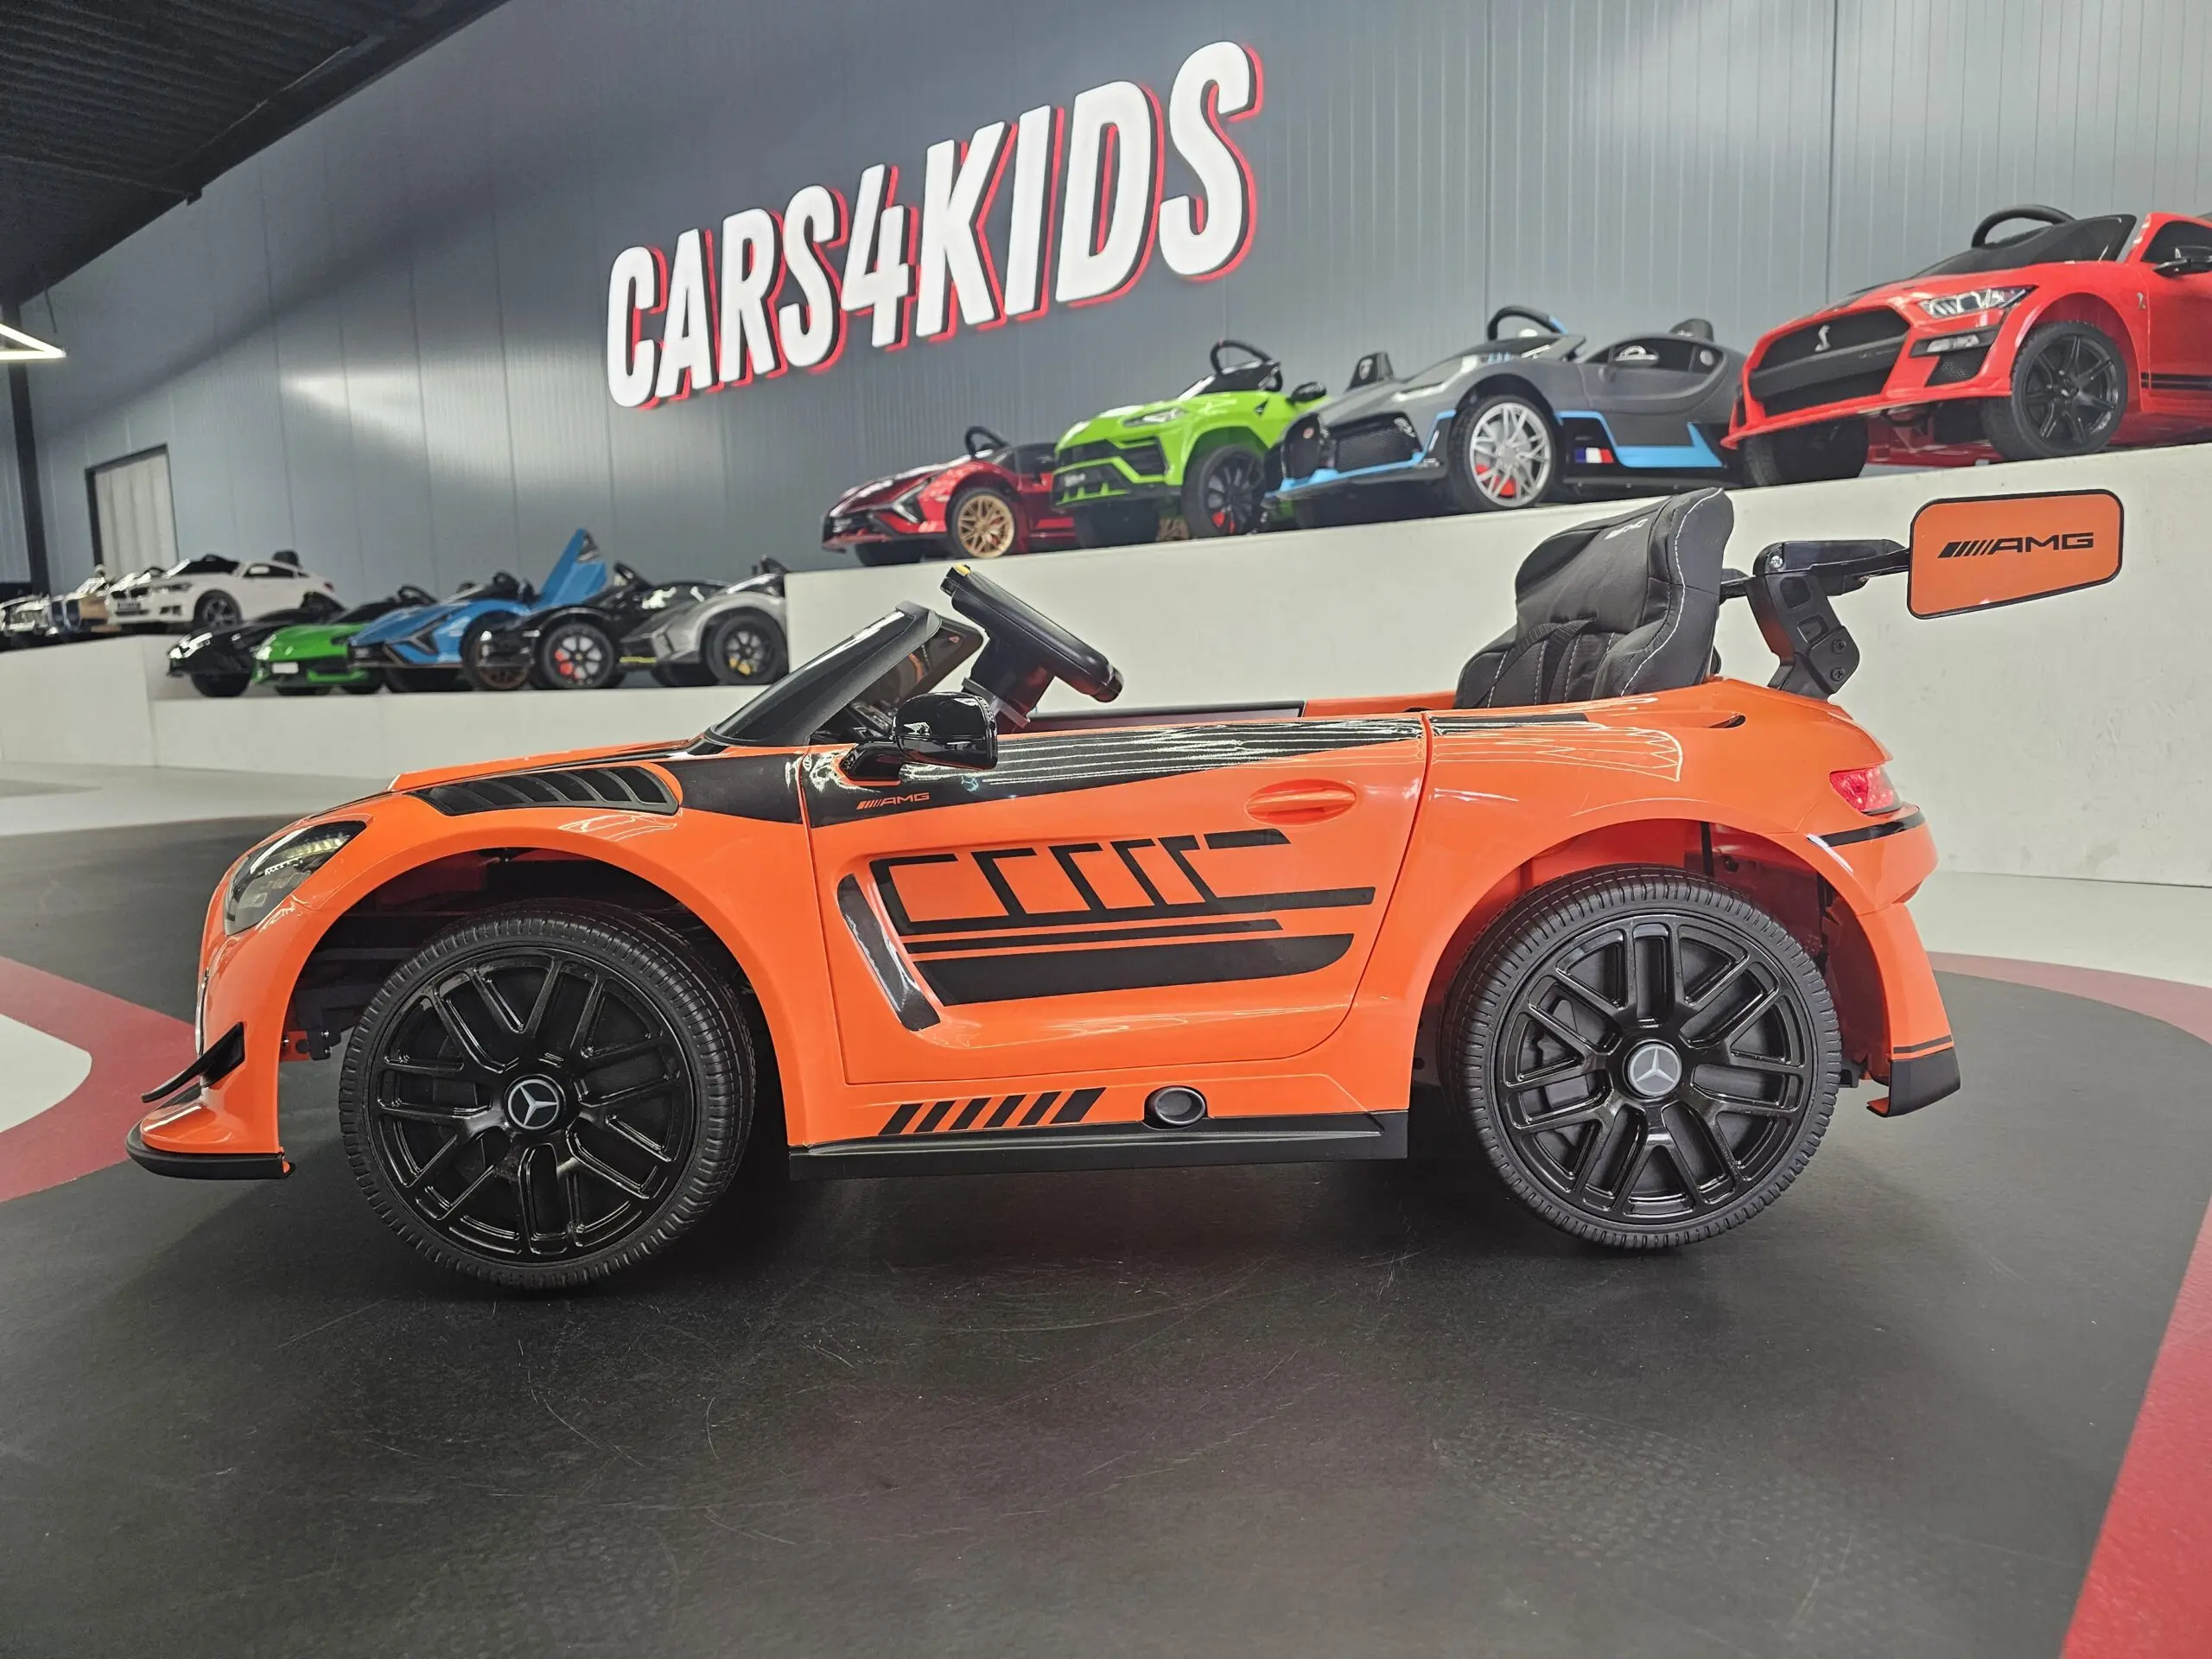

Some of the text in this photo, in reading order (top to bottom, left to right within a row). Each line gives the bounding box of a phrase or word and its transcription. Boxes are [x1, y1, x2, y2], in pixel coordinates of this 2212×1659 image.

[607, 40, 1262, 410] CARS4KIDS
[1986, 531, 2094, 556] AMG
[880, 791, 931, 807] AMG
